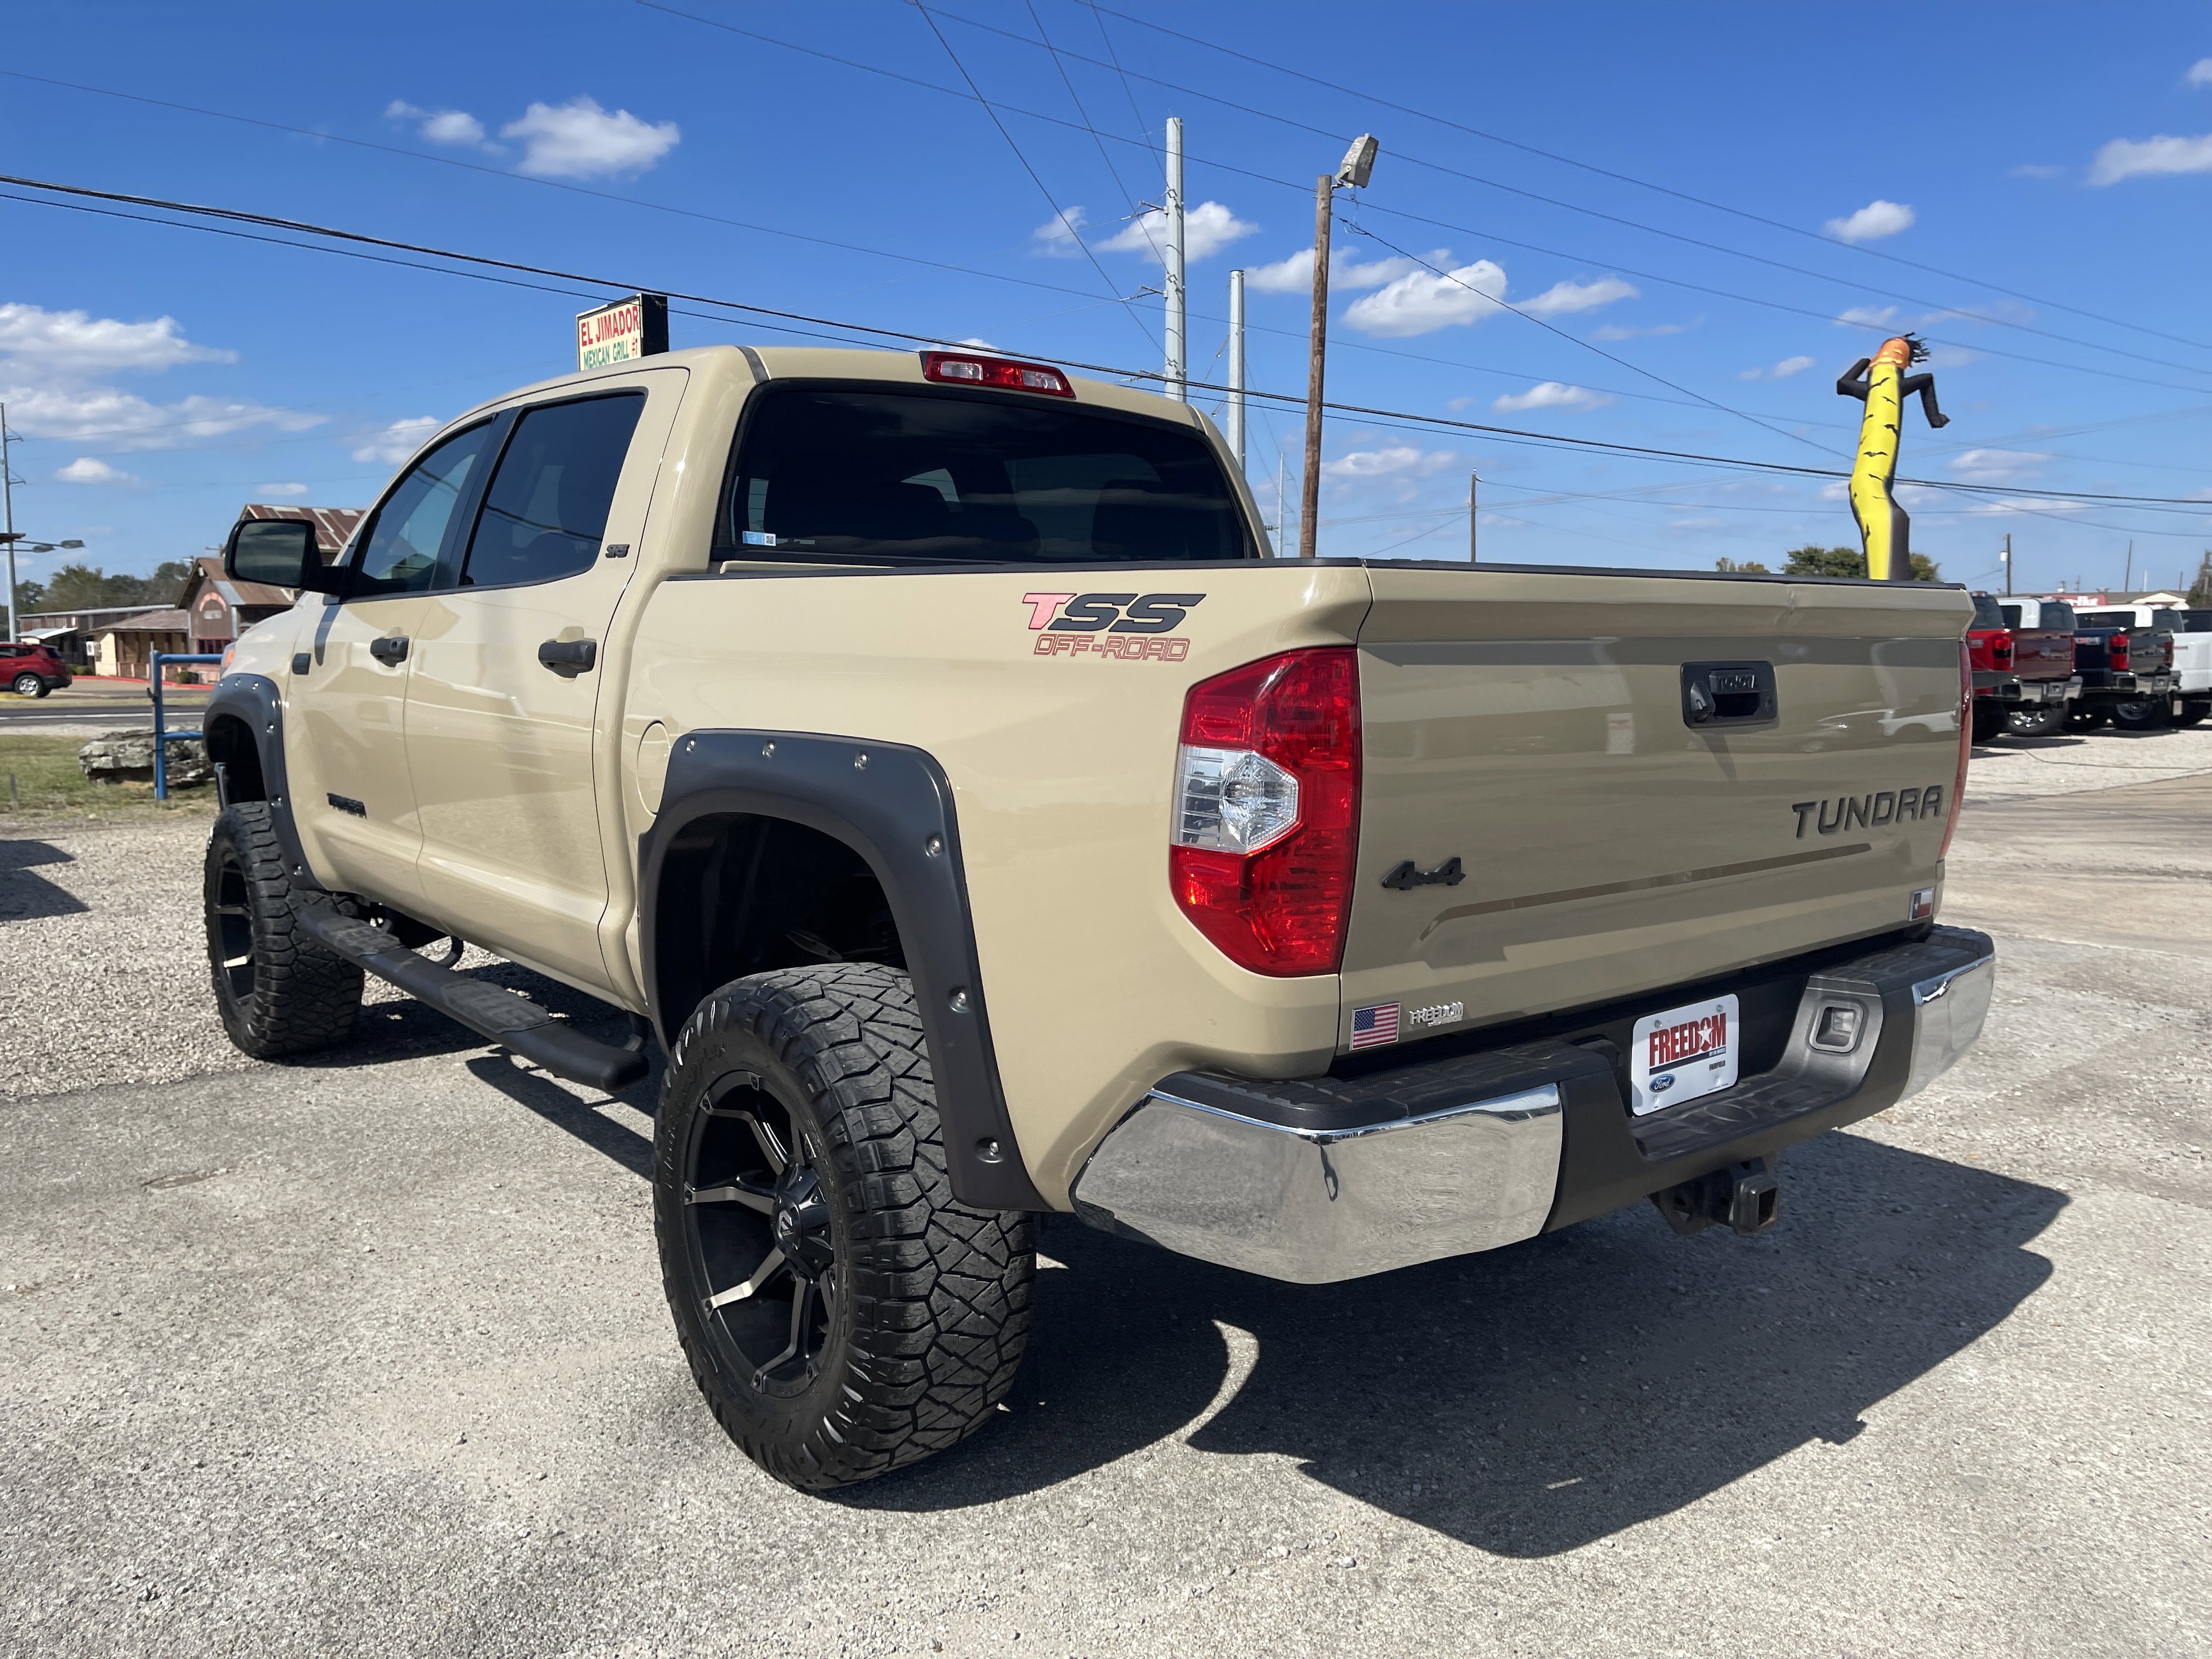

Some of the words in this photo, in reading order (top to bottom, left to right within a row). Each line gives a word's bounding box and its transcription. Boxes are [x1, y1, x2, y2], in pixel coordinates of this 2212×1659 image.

[581, 321, 593, 347] EL
[596, 306, 640, 343] JIMADOR
[583, 346, 610, 370] MEXICAN
[612, 340, 629, 362] GRILL
[1022, 592, 1206, 634] TSS
[1034, 634, 1190, 662] OFF-ROAD
[1792, 785, 1943, 839] TUNDRA
[1649, 1012, 1726, 1067] FREEDOM
